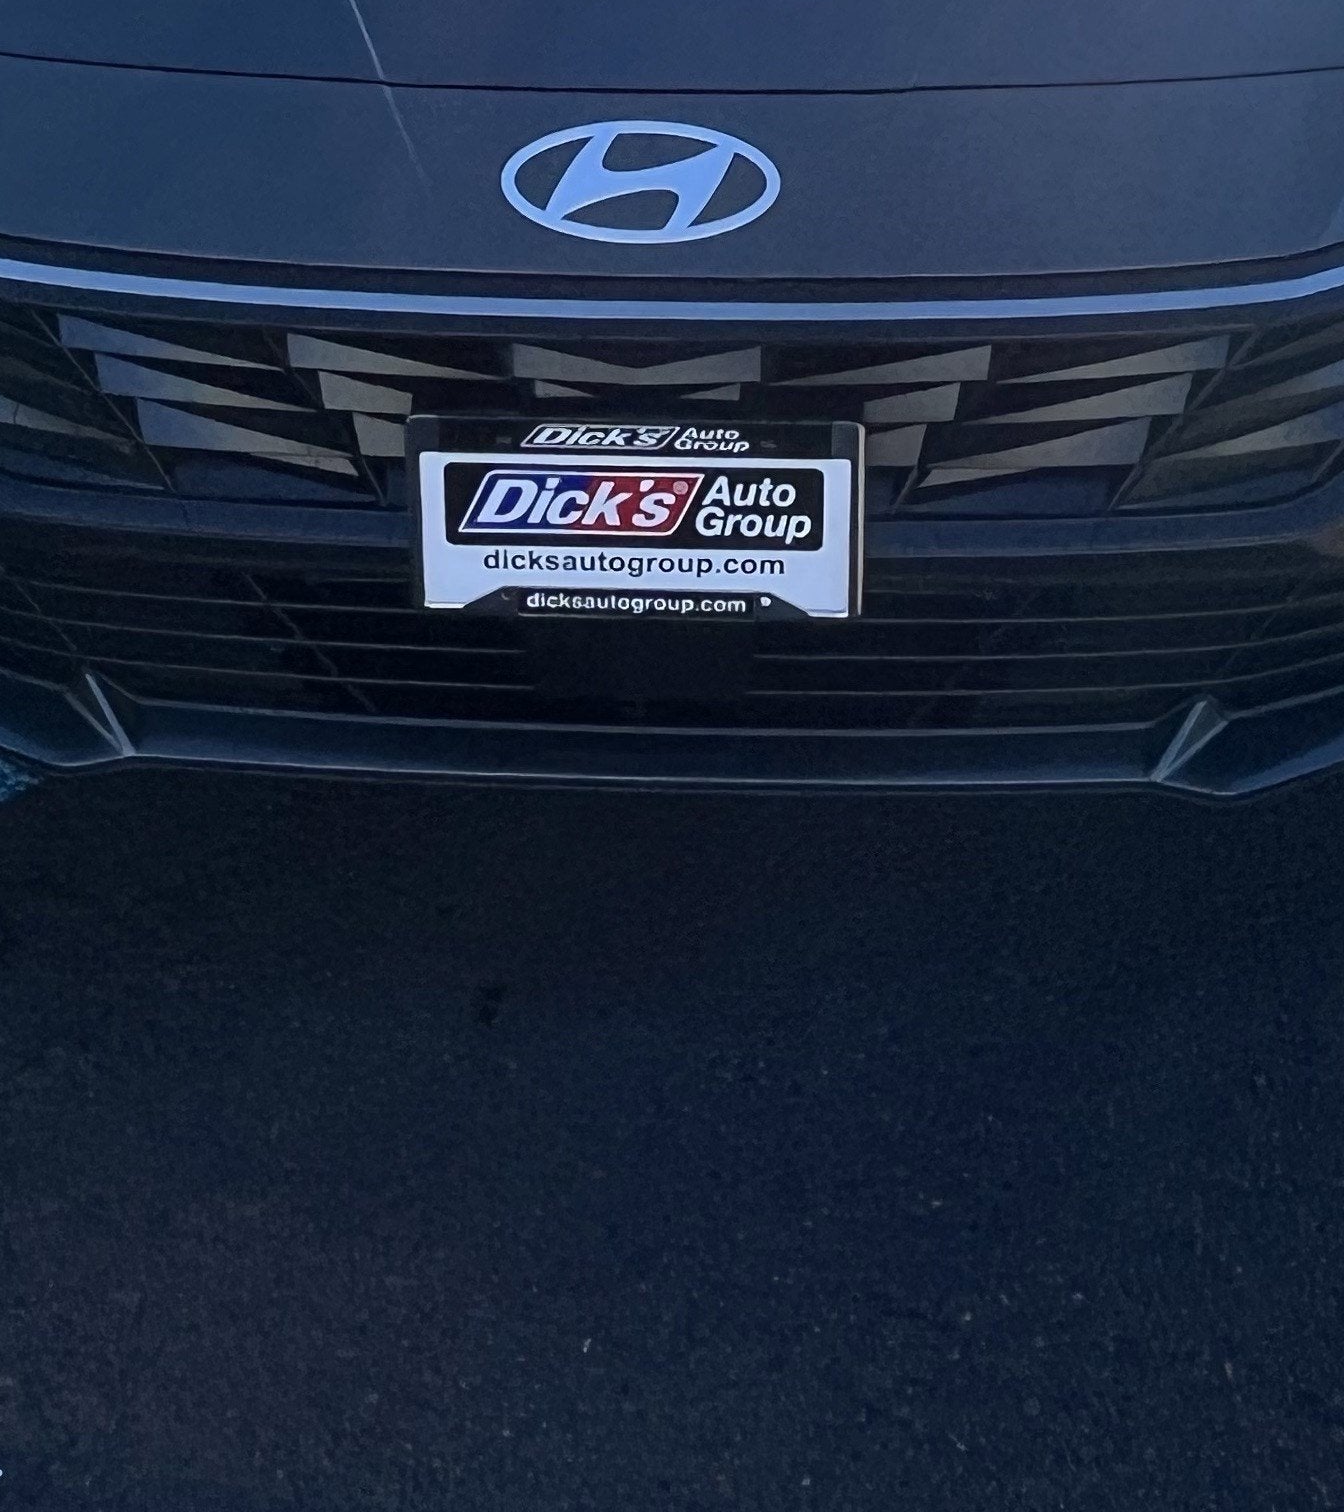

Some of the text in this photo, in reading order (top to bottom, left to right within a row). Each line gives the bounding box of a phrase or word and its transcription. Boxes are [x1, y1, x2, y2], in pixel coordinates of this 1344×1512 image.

[533, 425, 739, 447] Dick's Auto
[674, 439, 749, 453] Group
[476, 476, 796, 527] Dick's Auto
[695, 507, 812, 545] Group
[483, 549, 785, 577] dicksautogroup.com
[526, 591, 746, 613] dicksautogroup.com
